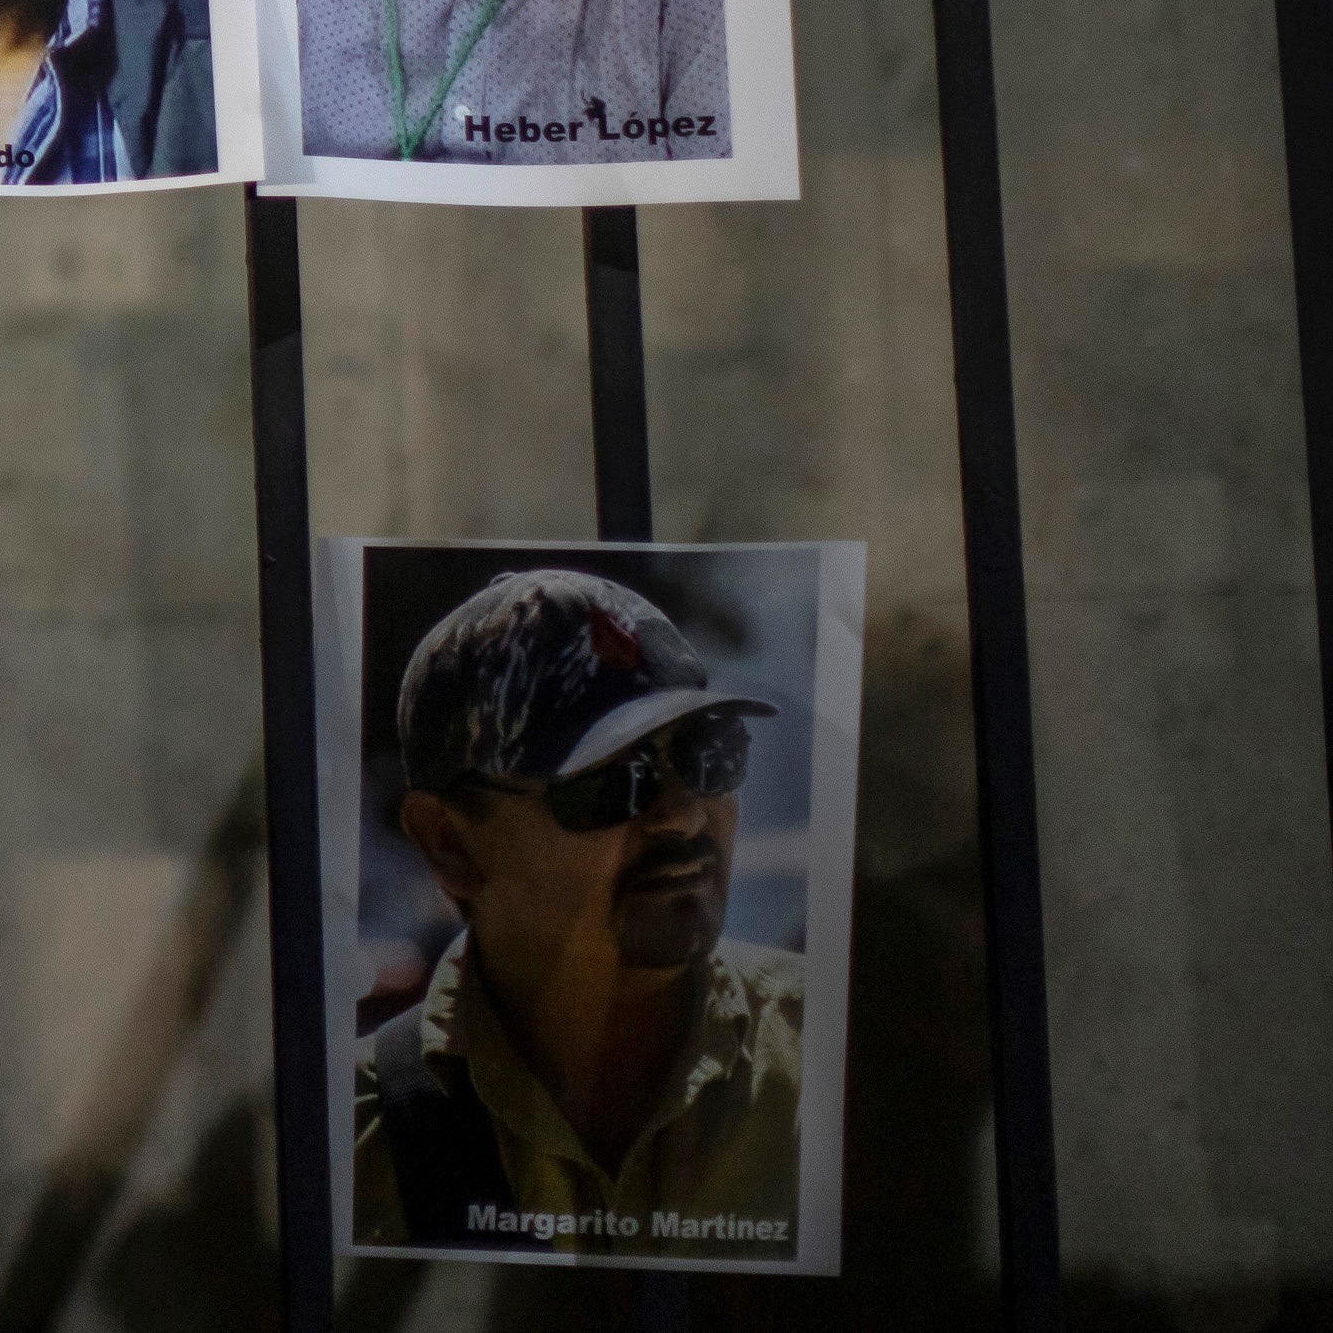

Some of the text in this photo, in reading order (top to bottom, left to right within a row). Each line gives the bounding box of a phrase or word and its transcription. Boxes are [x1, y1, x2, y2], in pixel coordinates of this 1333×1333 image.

[464, 111, 719, 146] Heber López
[467, 1203, 639, 1241] Margarito
